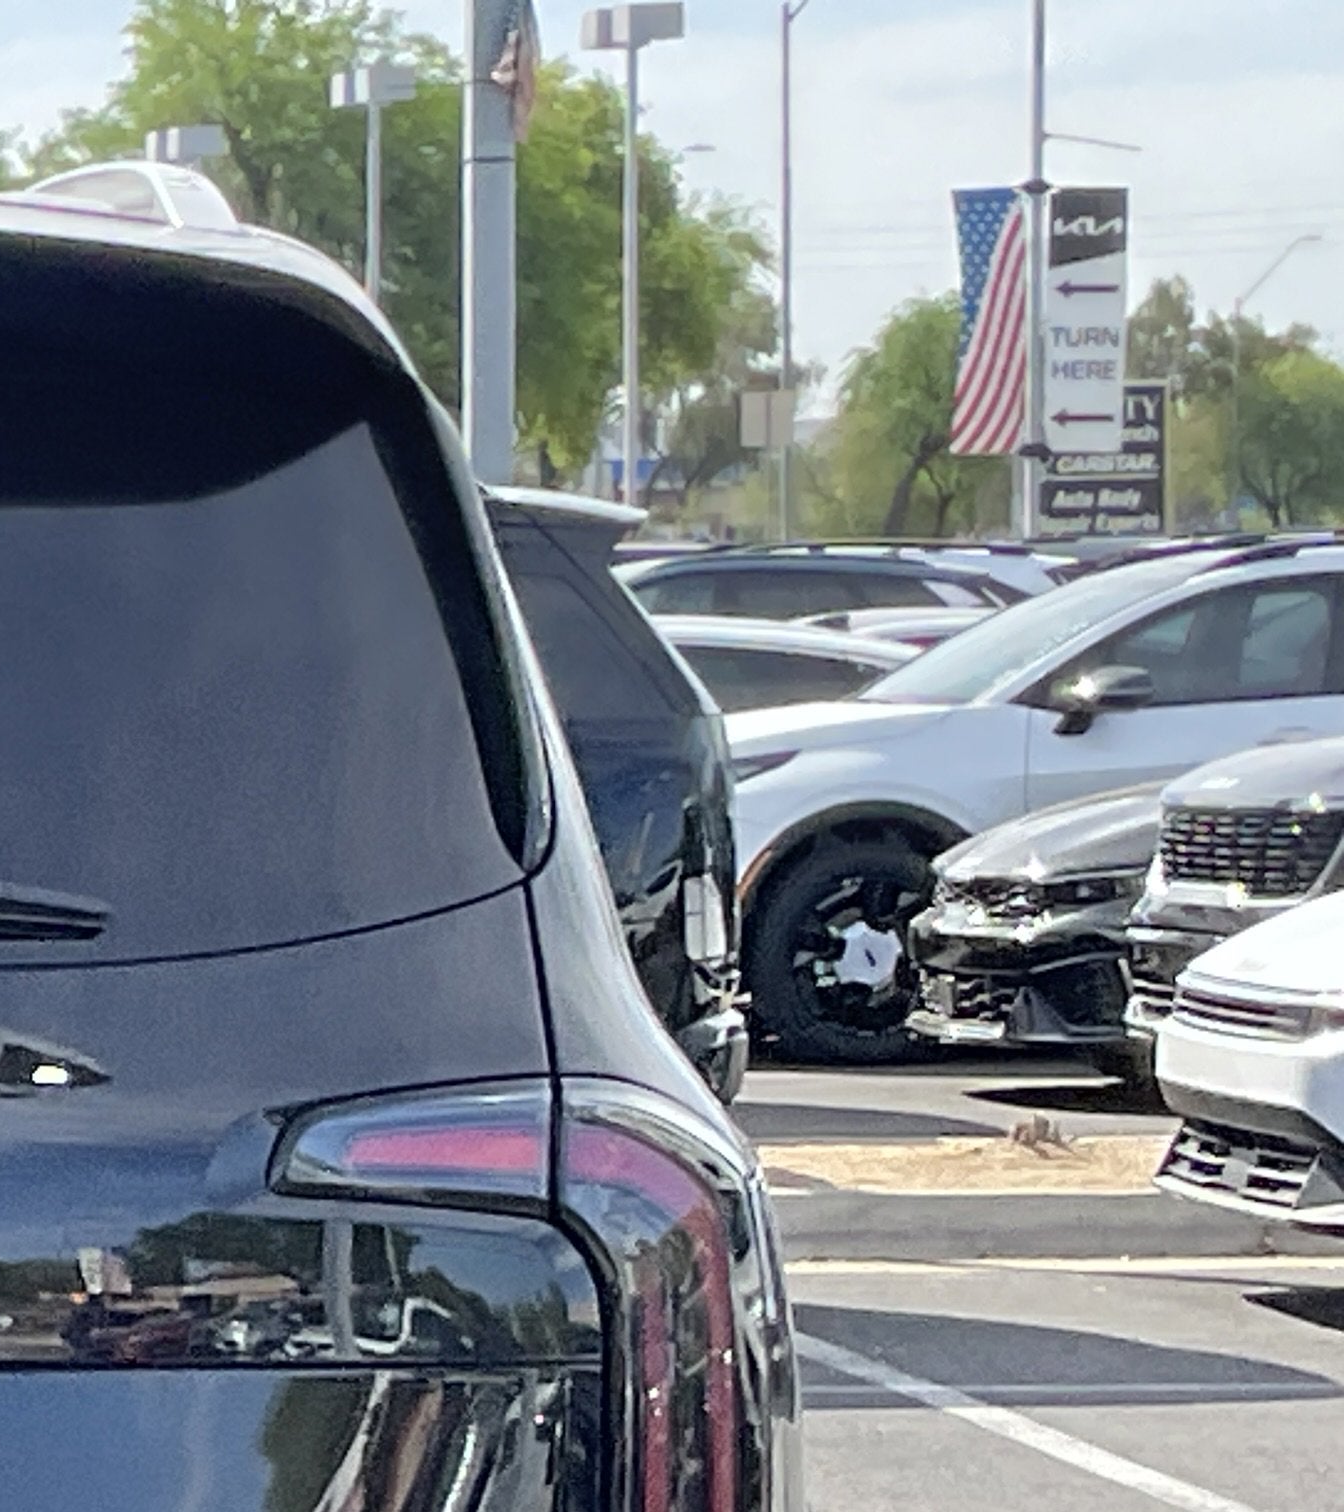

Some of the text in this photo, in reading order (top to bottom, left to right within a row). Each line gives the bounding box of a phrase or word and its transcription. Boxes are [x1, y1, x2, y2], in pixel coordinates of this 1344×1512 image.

[1053, 216, 1124, 236] KIA
[1050, 326, 1120, 349] TURN
[1050, 359, 1118, 381] HERE
